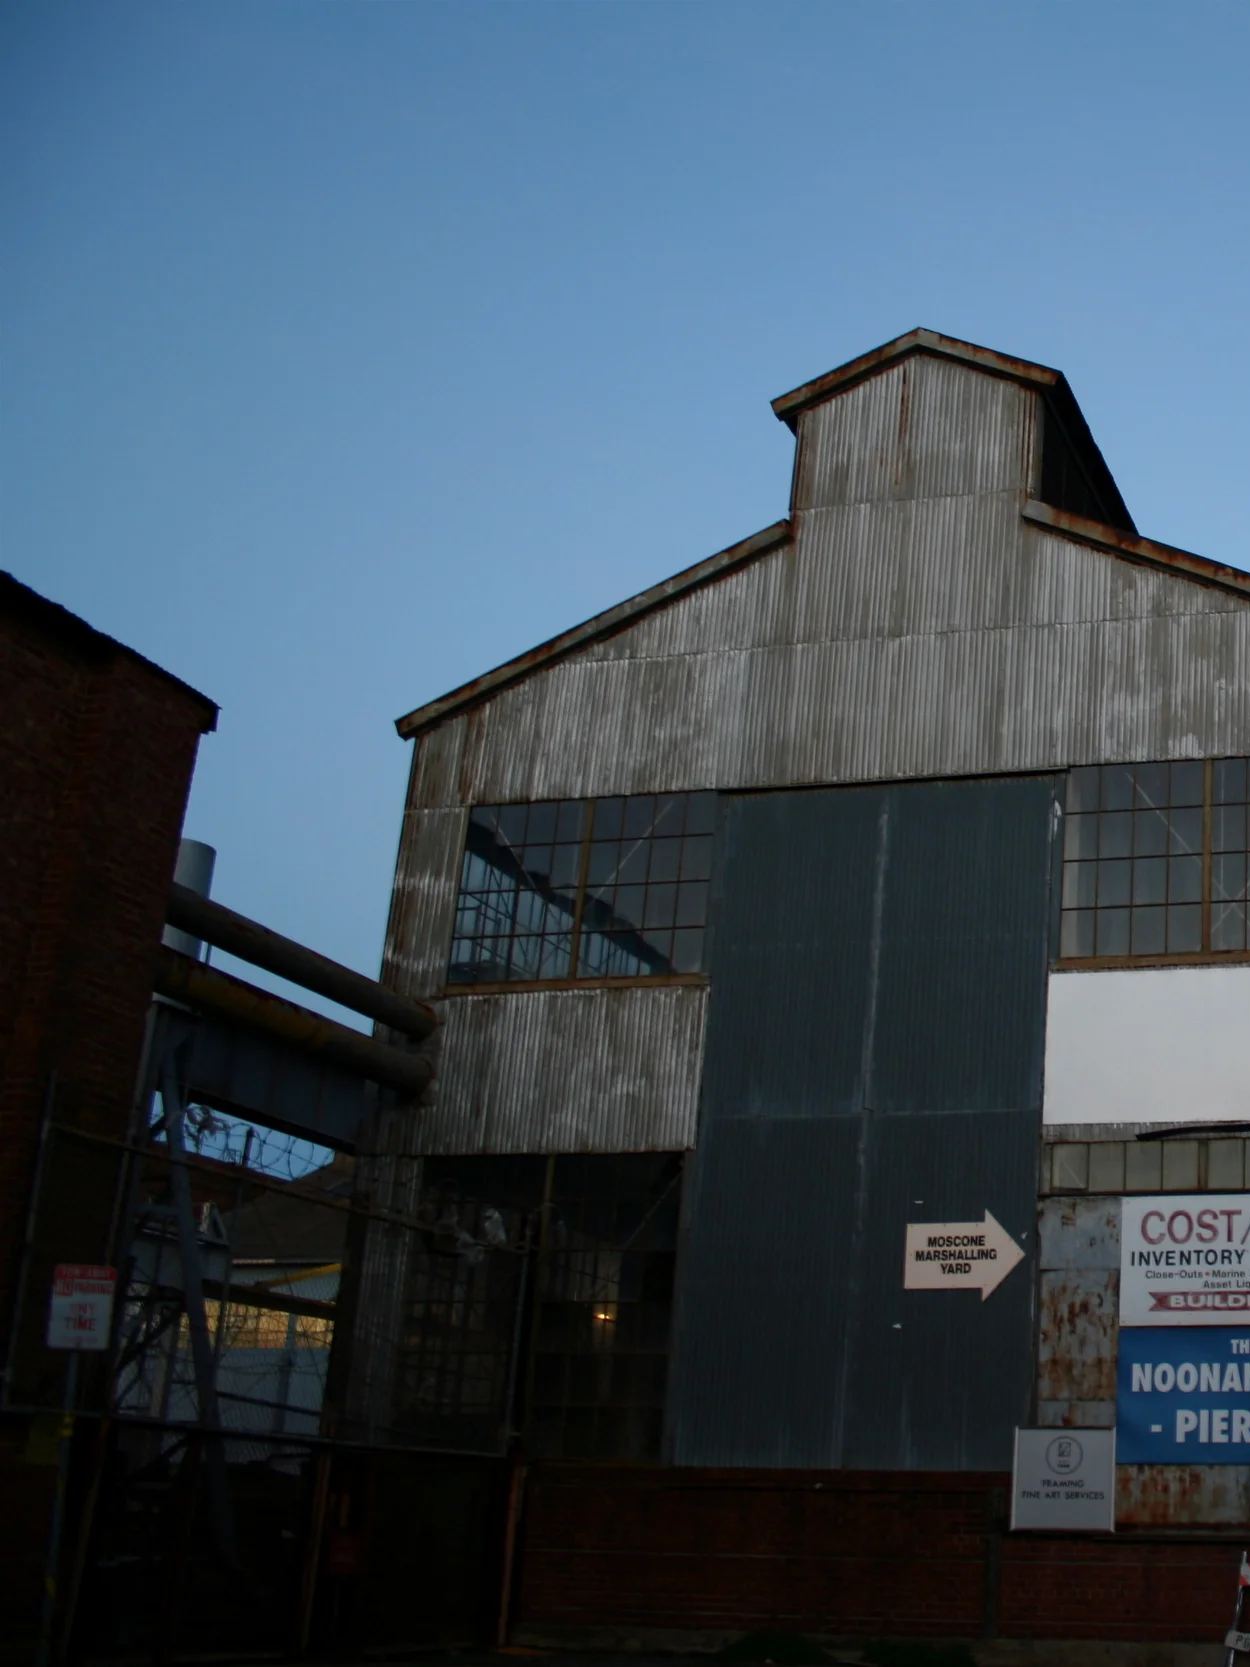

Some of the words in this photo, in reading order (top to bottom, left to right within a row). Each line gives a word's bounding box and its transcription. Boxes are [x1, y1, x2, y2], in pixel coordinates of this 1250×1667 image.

[928, 1236, 985, 1247] MOSCONE
[915, 1249, 997, 1261] MARSHALLING
[1131, 1249, 1245, 1267] INVENTORY
[940, 1263, 972, 1274] YARD
[1145, 1269, 1203, 1279] Close-Outs
[1212, 1268, 1246, 1278] Marine
[1203, 1279, 1232, 1289] Asset
[64, 1317, 97, 1331] TIME
[1042, 1479, 1084, 1488] FRAMING
[1022, 1491, 1040, 1500] FINE
[1045, 1491, 1060, 1500] ART
[1065, 1491, 1105, 1500] SERVICES
